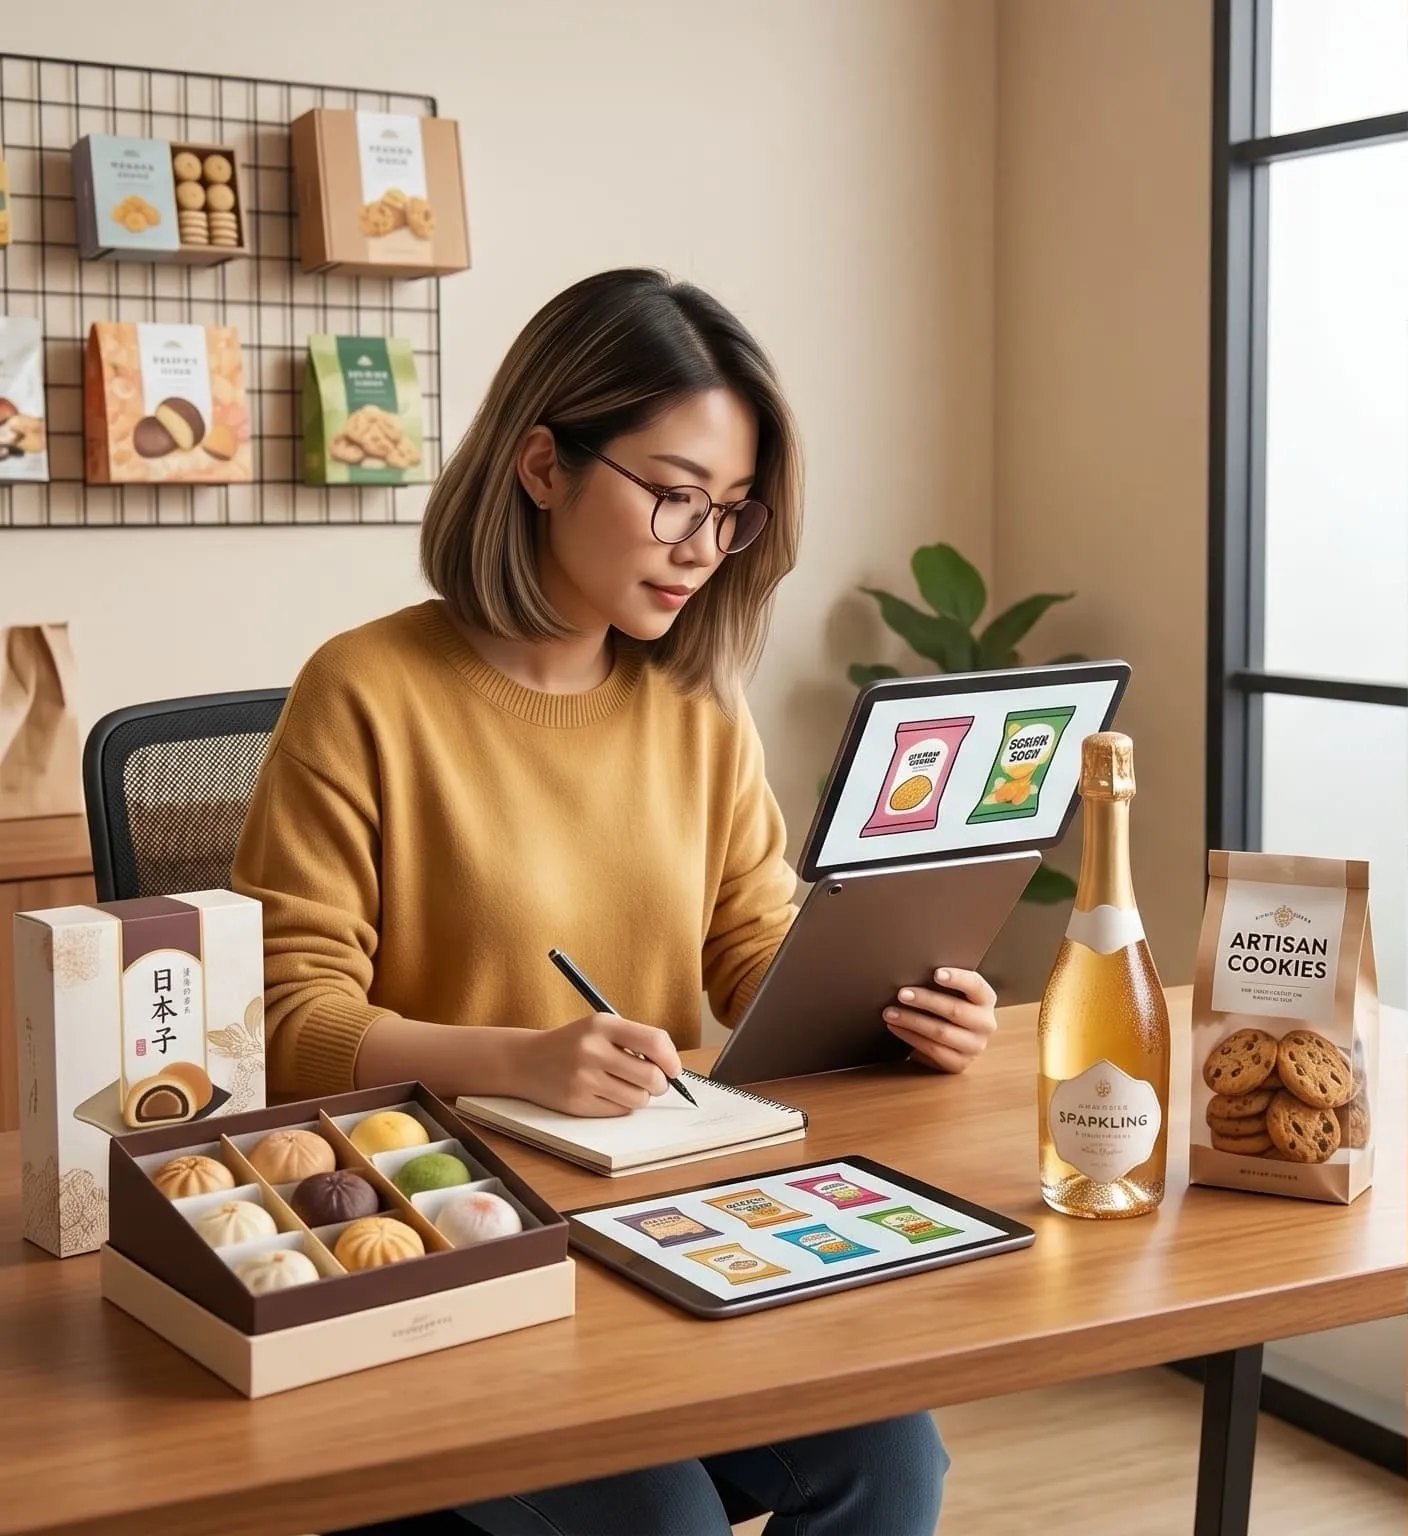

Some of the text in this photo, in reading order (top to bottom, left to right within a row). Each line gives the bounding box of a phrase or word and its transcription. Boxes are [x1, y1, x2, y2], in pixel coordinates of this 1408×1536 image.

[1229, 932, 1328, 956] ARTISAN
[1227, 954, 1327, 979] COOKIES
[151, 968, 178, 1055] 日本子
